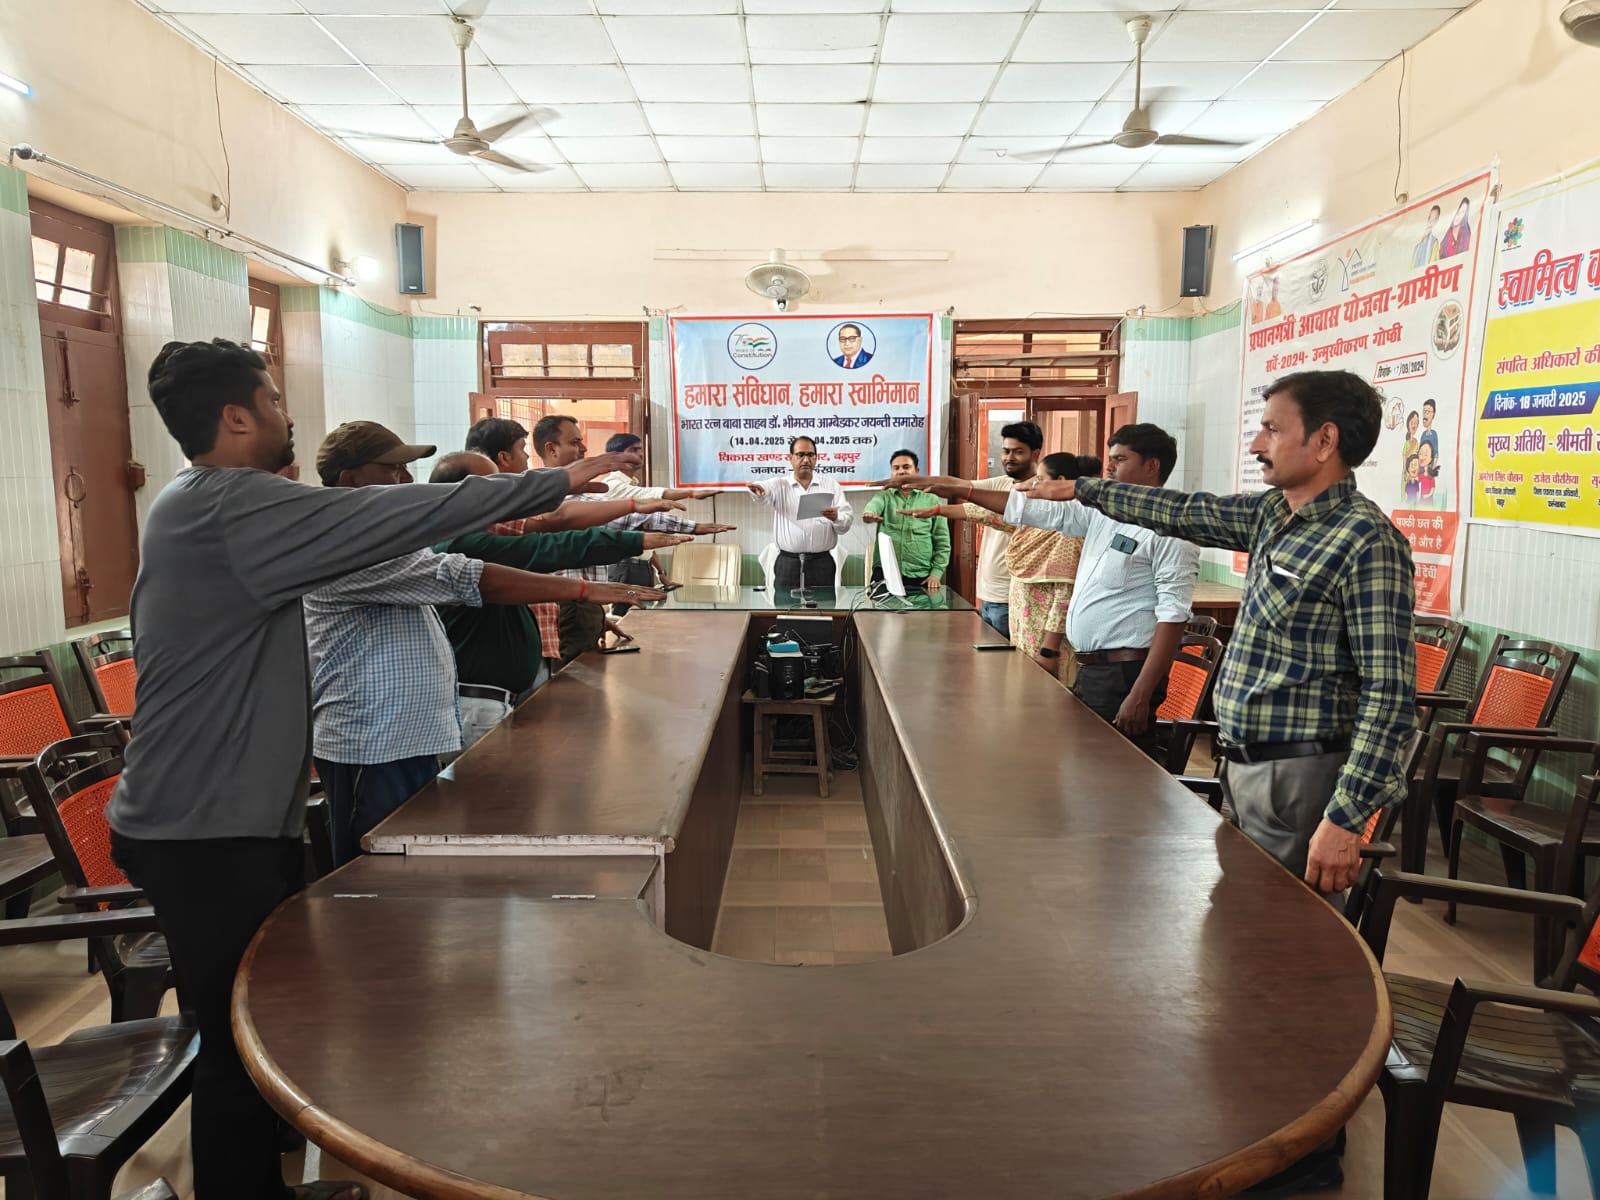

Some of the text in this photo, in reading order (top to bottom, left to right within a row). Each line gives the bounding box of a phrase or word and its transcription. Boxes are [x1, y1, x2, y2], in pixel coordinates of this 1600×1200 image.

[1498, 248, 1584, 309] स्वामित्व
[1249, 313, 1297, 352] प्रधानमंत्री
[1298, 304, 1342, 337] आवास
[1372, 322, 1404, 347] गोष्ठी
[1496, 355, 1528, 375] संपत्ति
[684, 383, 728, 410] हमारा
[798, 382, 844, 408] हमारा
[847, 373, 921, 407] स्वाभिमान
[1519, 395, 1530, 410] 18
[1531, 389, 1557, 410] जनवरी
[1558, 391, 1586, 407] 2025
[681, 418, 703, 431] भारत
[704, 418, 721, 430] रत्न
[722, 417, 742, 430] बाबा
[743, 418, 767, 430] साहब
[782, 414, 816, 430] भीमराव
[816, 414, 860, 429] आम्बेडकर
[861, 413, 891, 429] जयन्ती
[892, 413, 925, 429] समारोह
[729, 435, 785, 448] (14.04.2025
[852, 434, 878, 447] तक)
[1487, 435, 1511, 458] मुख्य
[1513, 427, 1546, 452] अतिथि
[1556, 426, 1593, 452] श्रीमती
[718, 451, 755, 463] विकास
[756, 452, 782, 462] खण्ड
[750, 466, 786, 475] जनपद
[1432, 515, 1444, 530] की
[1436, 535, 1443, 550] है
